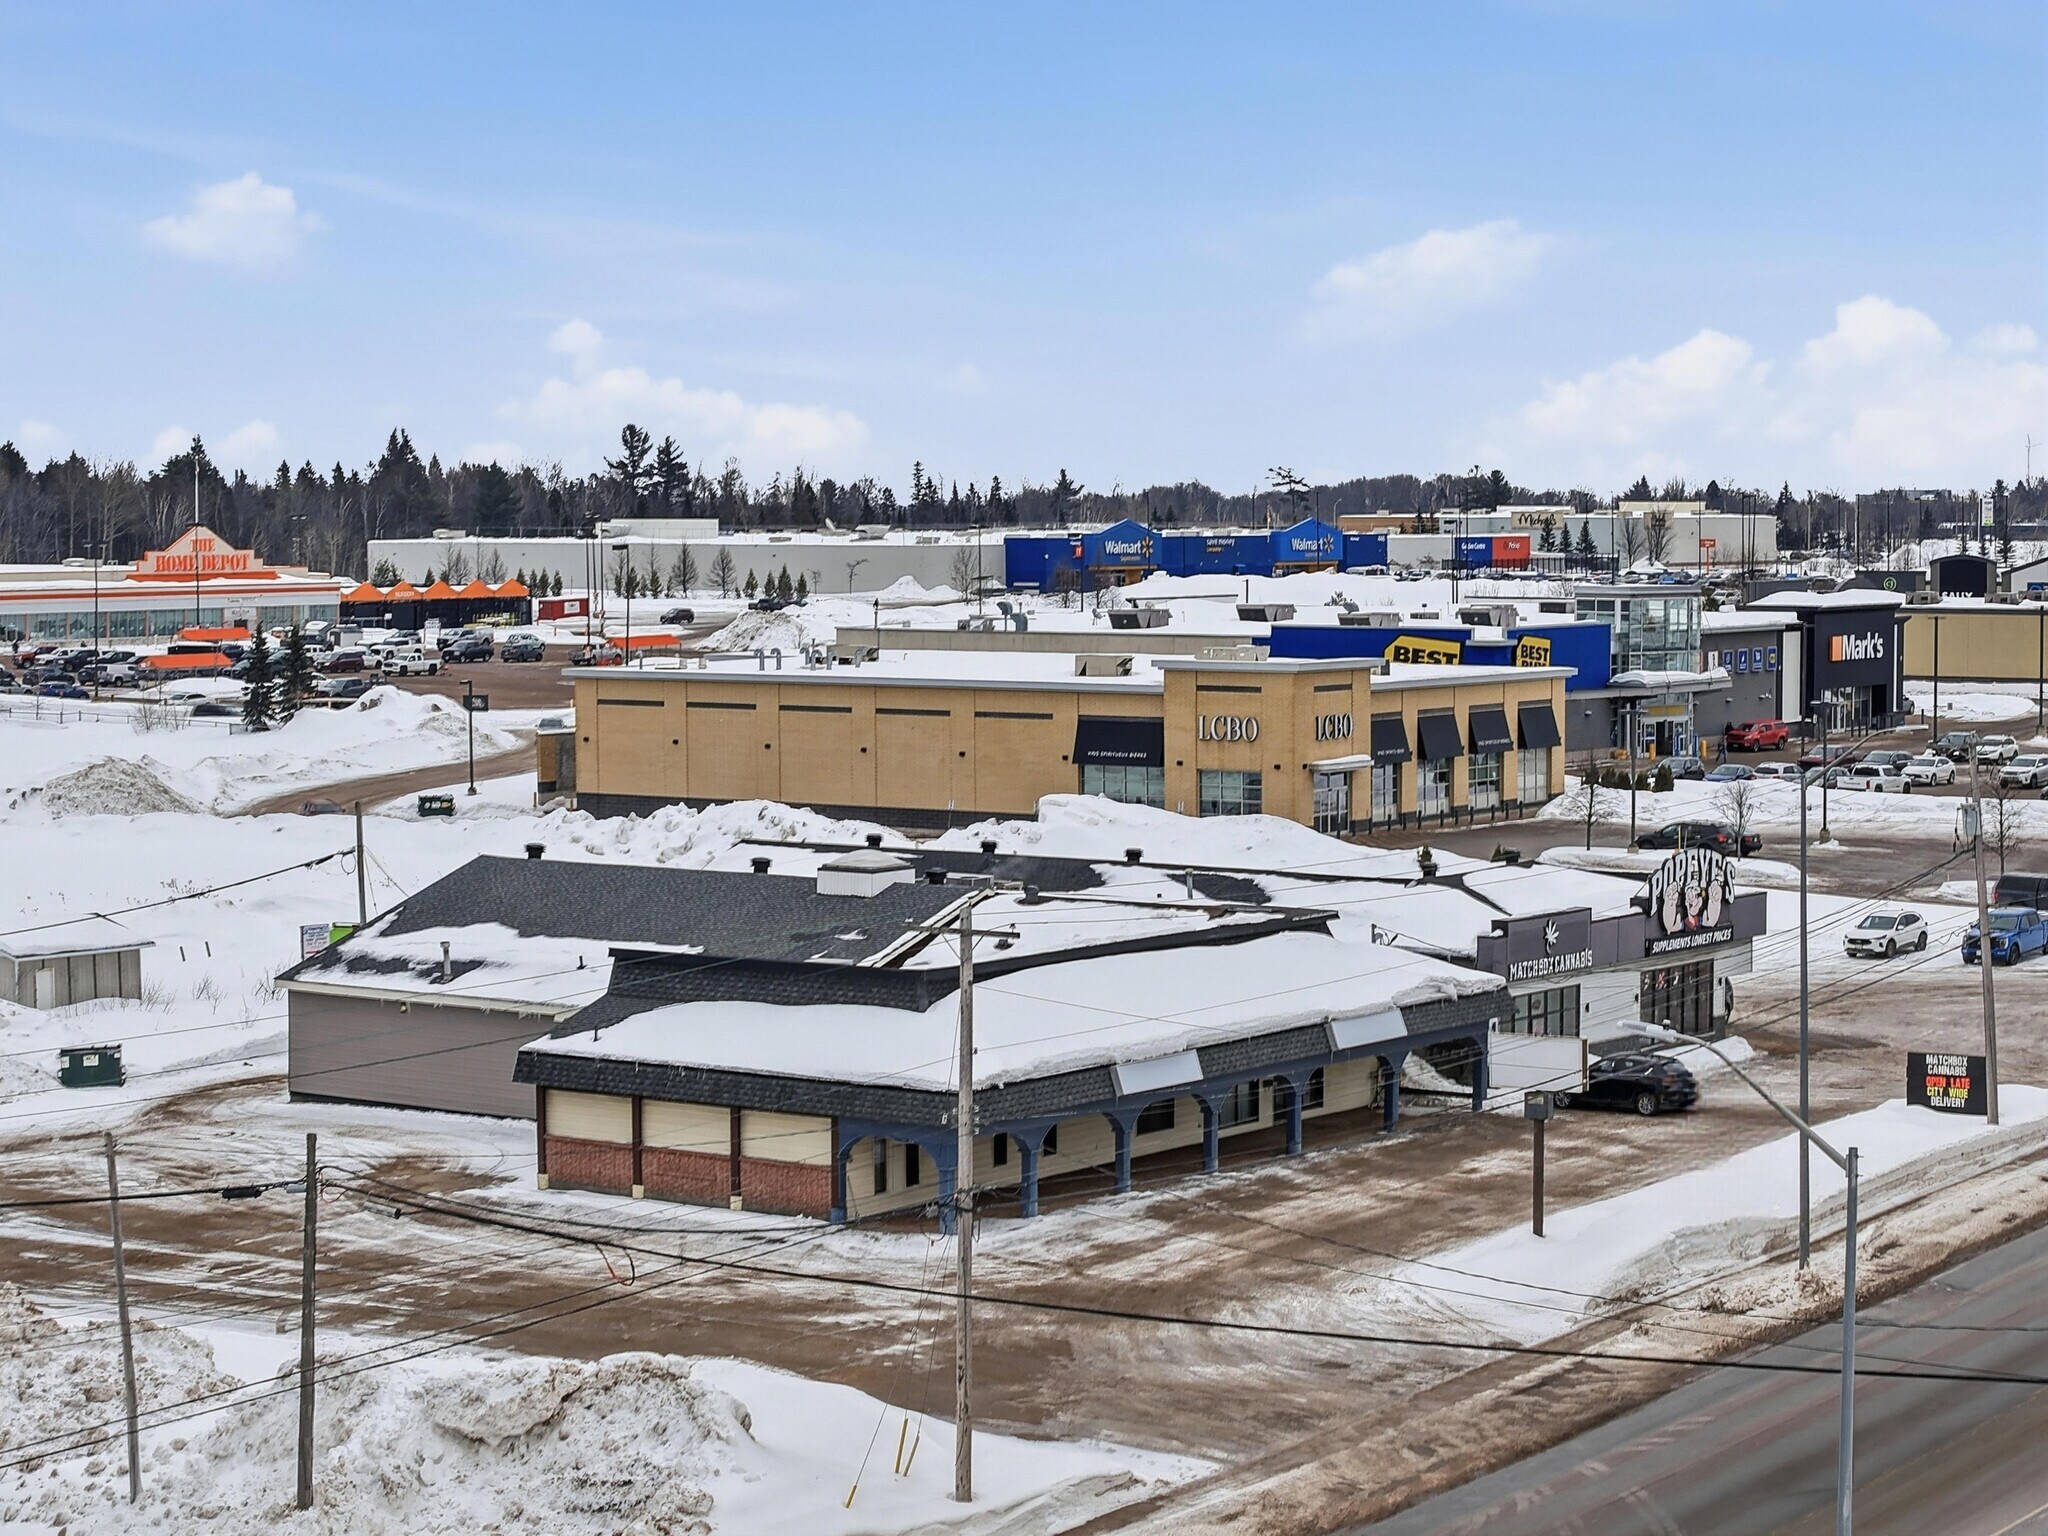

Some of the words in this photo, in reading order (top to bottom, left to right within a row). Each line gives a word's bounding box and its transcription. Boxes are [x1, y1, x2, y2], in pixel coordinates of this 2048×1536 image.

[190, 538, 214, 552] THE
[1104, 540, 1141, 554] Walmart
[1291, 537, 1324, 551] Walmat
[154, 555, 196, 572] HOME
[201, 553, 249, 570] DEPOT
[1520, 644, 1549, 660] BEST
[1842, 632, 1883, 661] Mark's
[1393, 646, 1458, 666] BEST
[1198, 715, 1259, 742] LCBO
[1315, 713, 1353, 741] LCBO
[1650, 848, 1735, 917] POPEYE'S
[1652, 935, 1691, 954] SUPPLEMENTS
[1691, 931, 1712, 946] LOWEST
[1713, 928, 1732, 942] PRICES
[1509, 956, 1554, 981] MATCHBOX
[1554, 948, 1593, 972] CANNABIS
[1926, 1054, 1968, 1067] MATCHBOX
[1927, 1065, 1967, 1076] CANNABIS
[1926, 1076, 1946, 1087] OPEN
[1950, 1077, 1970, 1088] LATE
[1927, 1086, 1944, 1096] CITY
[1948, 1087, 1968, 1098] WIDE
[1930, 1097, 1966, 1108] DELIVERY
